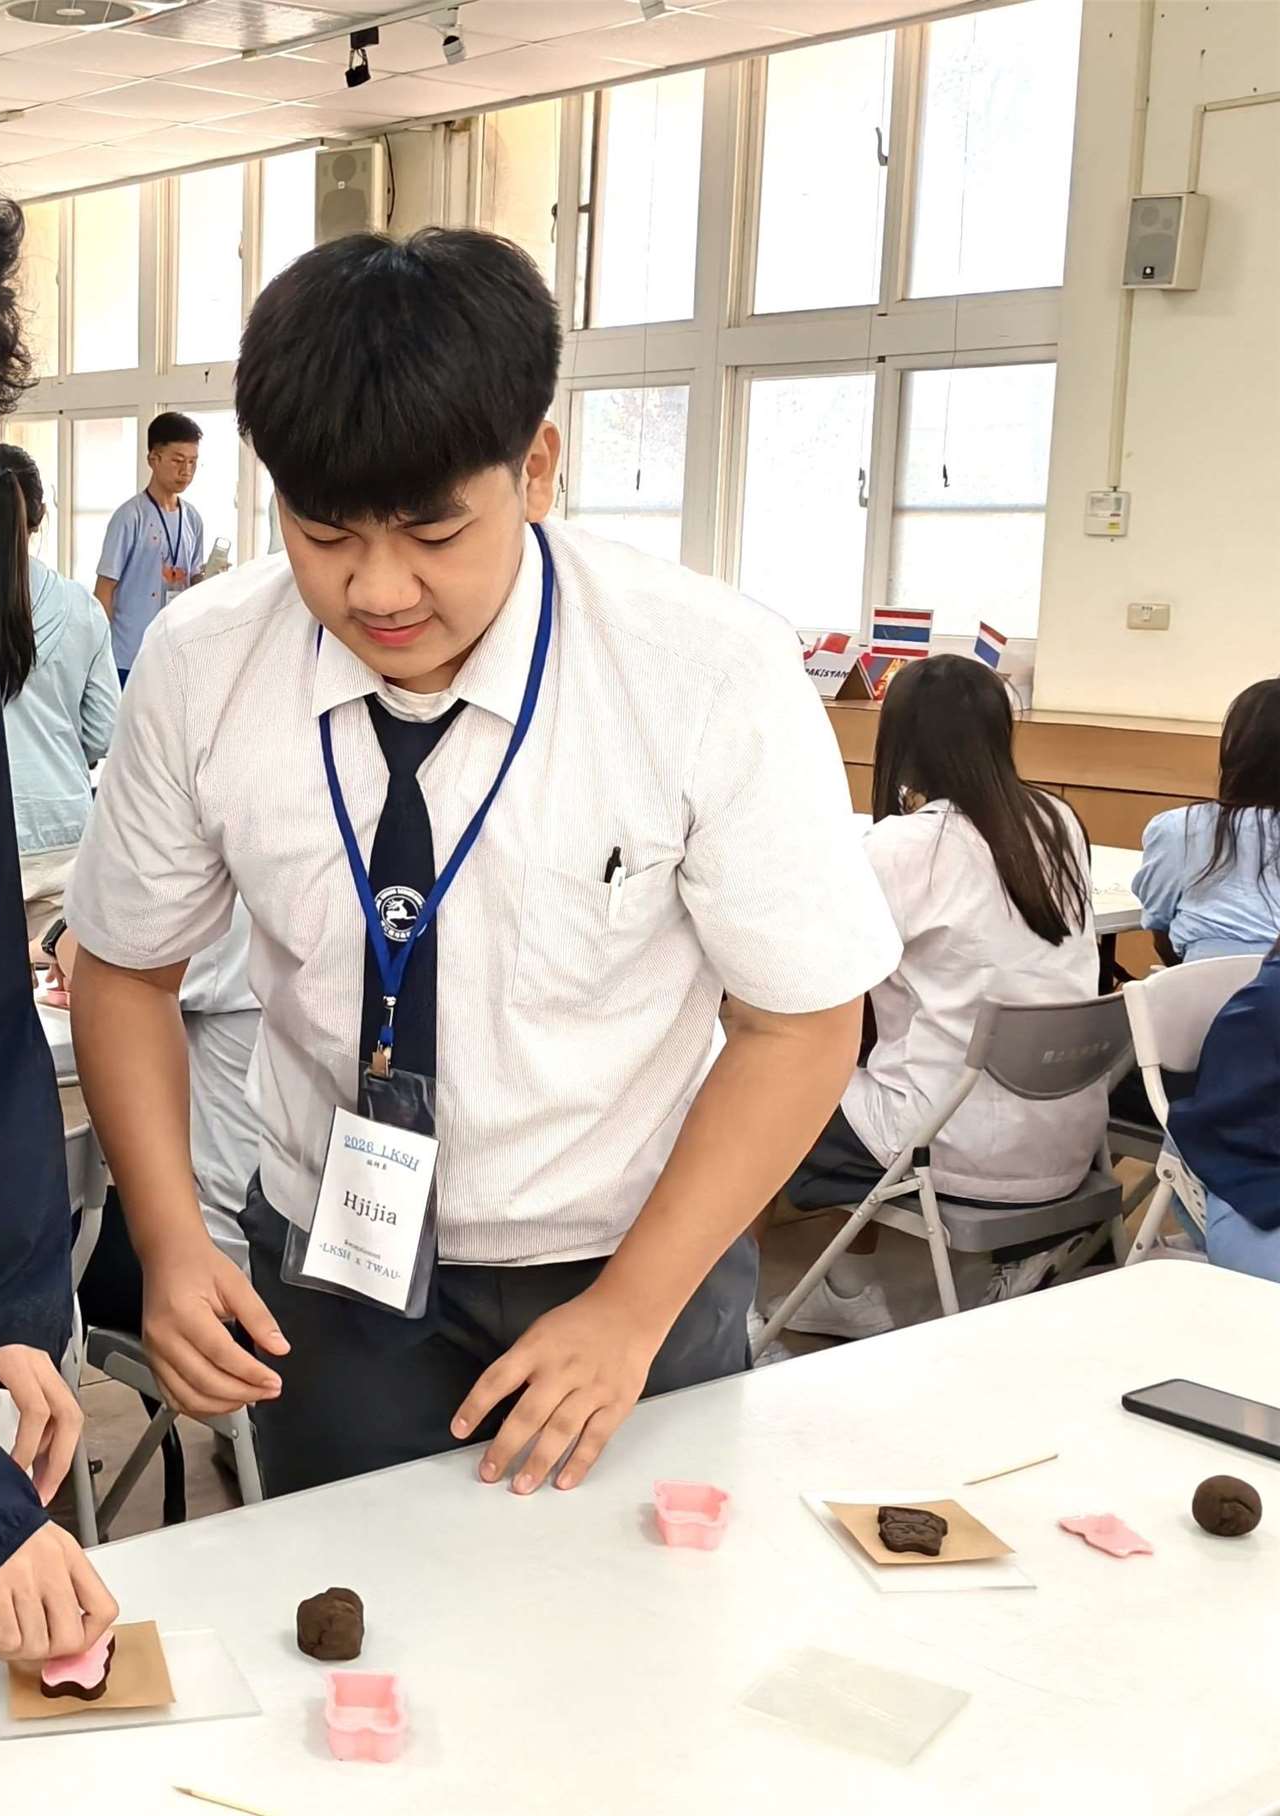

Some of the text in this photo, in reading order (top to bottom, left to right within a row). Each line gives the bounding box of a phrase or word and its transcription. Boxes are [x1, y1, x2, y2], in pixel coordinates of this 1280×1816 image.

[344, 1134, 375, 1154] 2026
[382, 1145, 420, 1172] LKSH
[344, 1190, 397, 1226] Hjijia
